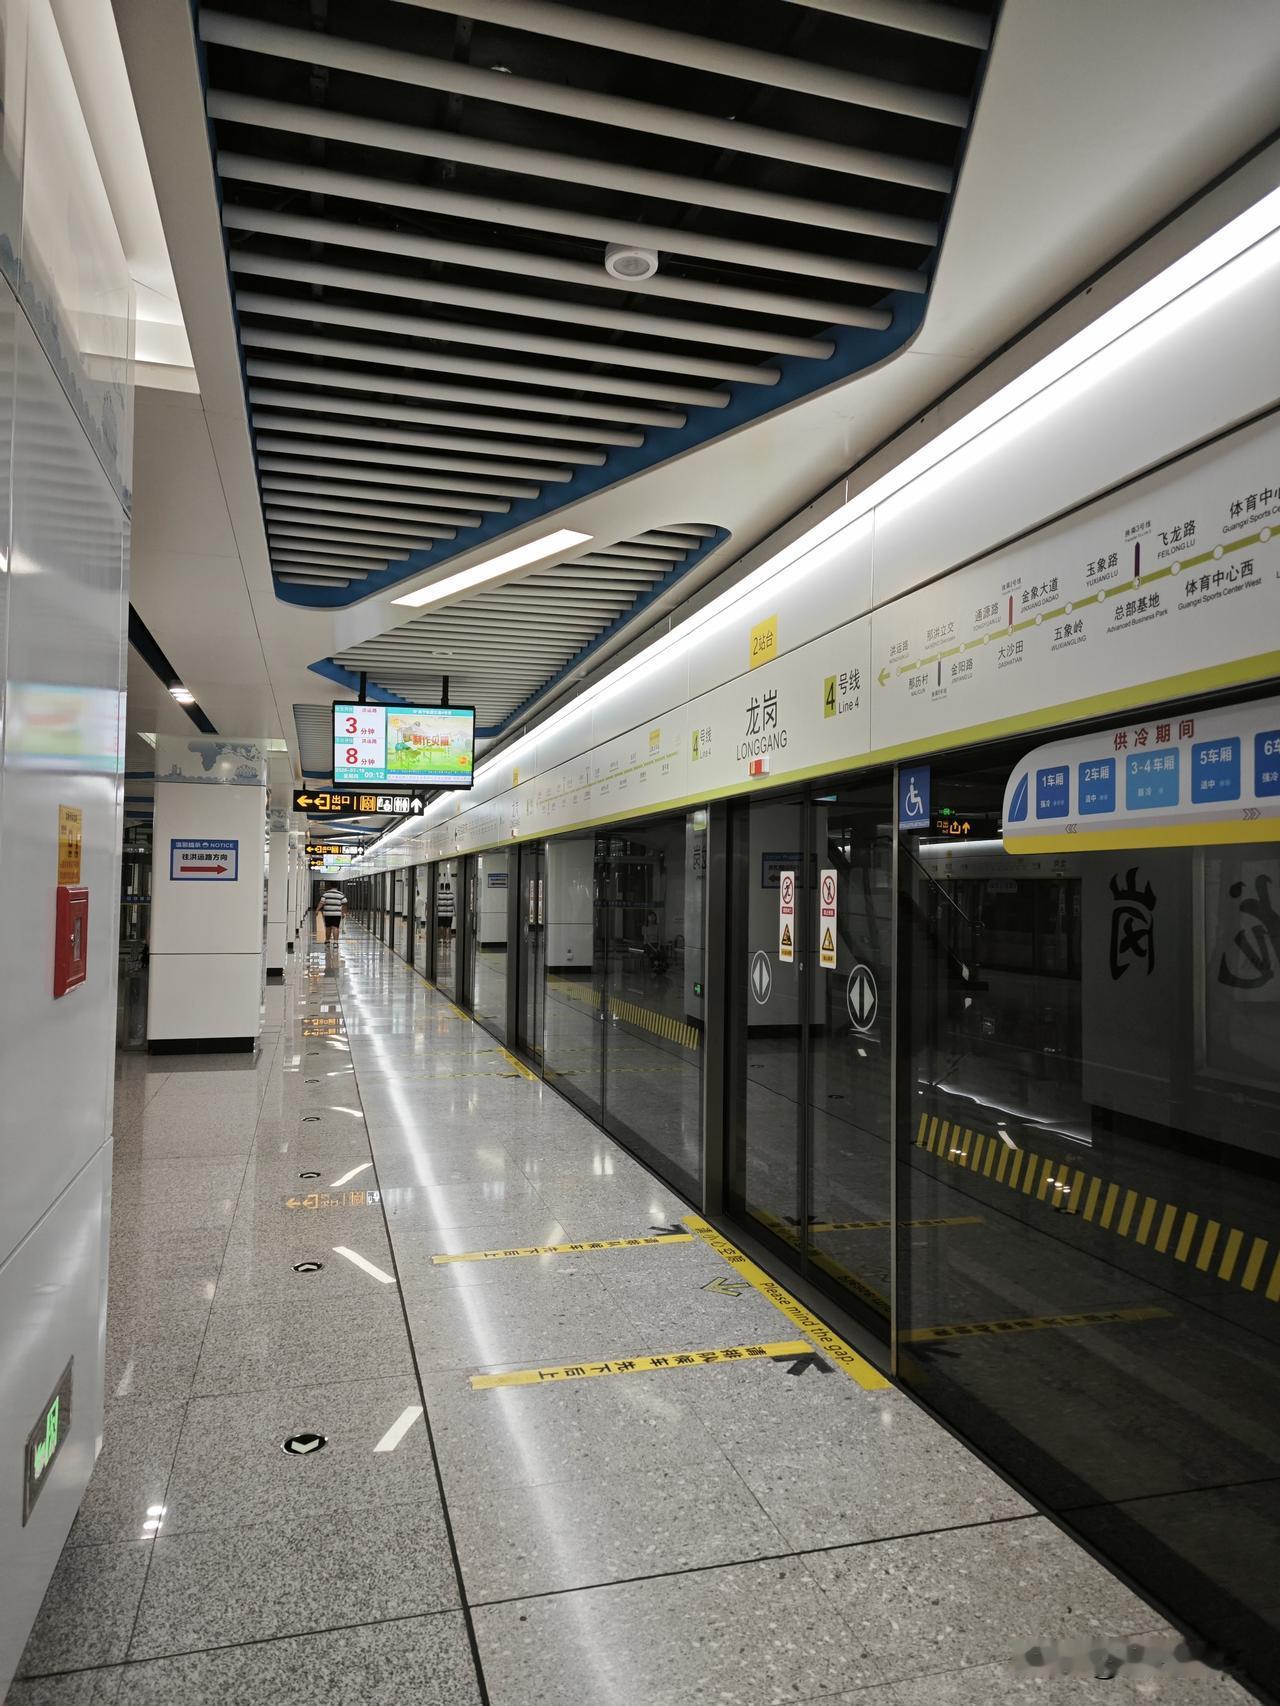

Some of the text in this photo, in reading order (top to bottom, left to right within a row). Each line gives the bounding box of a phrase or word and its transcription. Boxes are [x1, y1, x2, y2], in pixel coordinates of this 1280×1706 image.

[1222, 519, 1249, 534] Guangxi
[1250, 509, 1271, 525] Sports
[1157, 520, 1196, 546] 飞龙路
[1157, 538, 1196, 560] FEILONG LU
[1086, 552, 1119, 578] 玉象路
[1086, 569, 1119, 588] YUXIANG LU
[1184, 558, 1254, 598] 体育中心西
[1020, 577, 1059, 604] 金象大道
[1041, 593, 1060, 606] DADAO
[1178, 577, 1262, 611] Guangxi Sports Center West
[974, 602, 999, 622] 通源路
[1114, 592, 1160, 621] 总部基地
[1053, 618, 1084, 641] 五象岭
[1106, 608, 1168, 634] Advanced Business Park
[752, 630, 774, 656] 2站台
[998, 640, 1024, 661] 大沙田
[1051, 634, 1088, 652] WUXIANGLING
[951, 657, 973, 677] 金阳路
[838, 668, 861, 695] 号线
[825, 681, 836, 711] 4
[838, 696, 860, 714] Line 4
[746, 689, 778, 736] 龙岗
[345, 716, 358, 734] 3
[360, 727, 375, 735] 分钟
[1113, 718, 1195, 751] 供冷期间
[345, 747, 358, 764] 8
[736, 729, 788, 761] LONGGANG
[1199, 746, 1232, 765] 5车厢
[361, 758, 375, 766] 分钟
[1131, 755, 1175, 775] 3-4车厢
[1041, 772, 1064, 787] 1车厢
[1084, 765, 1110, 781] 2车厢
[331, 794, 350, 804] 出口
[181, 853, 228, 861] 往洪运路方向
[760, 1281, 855, 1366] Please mind the gap.
[537, 1360, 637, 1380] 先下后上
